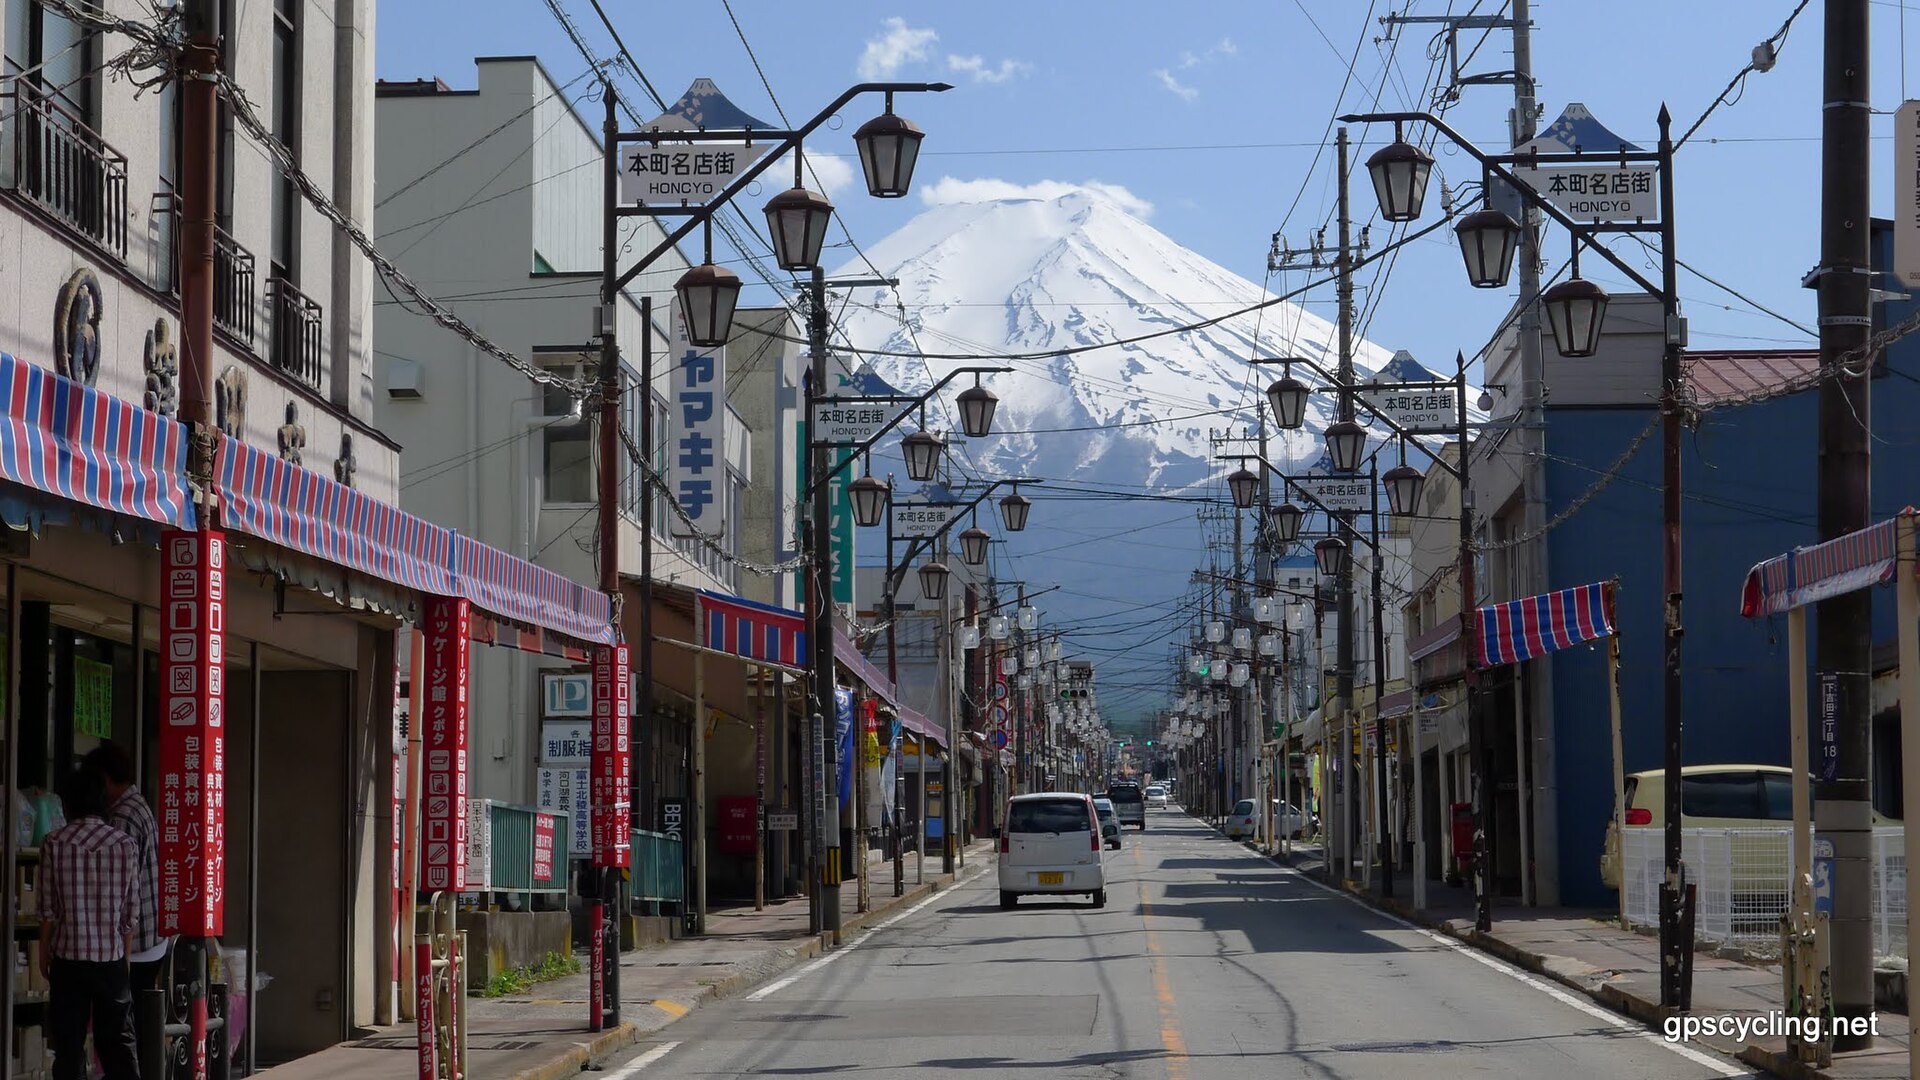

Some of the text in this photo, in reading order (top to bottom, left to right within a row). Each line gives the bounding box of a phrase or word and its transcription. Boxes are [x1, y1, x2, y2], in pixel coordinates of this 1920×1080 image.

[628, 152, 735, 176] 本町名店街
[1549, 172, 1651, 196] 本町名店街
[1385, 394, 1452, 412] 本町名店街
[819, 409, 884, 424] 本町名店街
[679, 349, 715, 520] ヤマキチ
[1316, 484, 1367, 496] 本町名店街
[897, 511, 946, 523] 本町名店街
[431, 601, 448, 745] パッケージ館 クボタ
[1826, 683, 1835, 742] 下吉田三丁目
[1823, 745, 1837, 757] 18
[184, 736, 199, 903] 包装資材・パッケージ
[472, 802, 482, 858] 日本キリスト教団
[164, 773, 179, 930] 典礼用品・生活雑貨
[421, 1045, 432, 1073] クボタ
